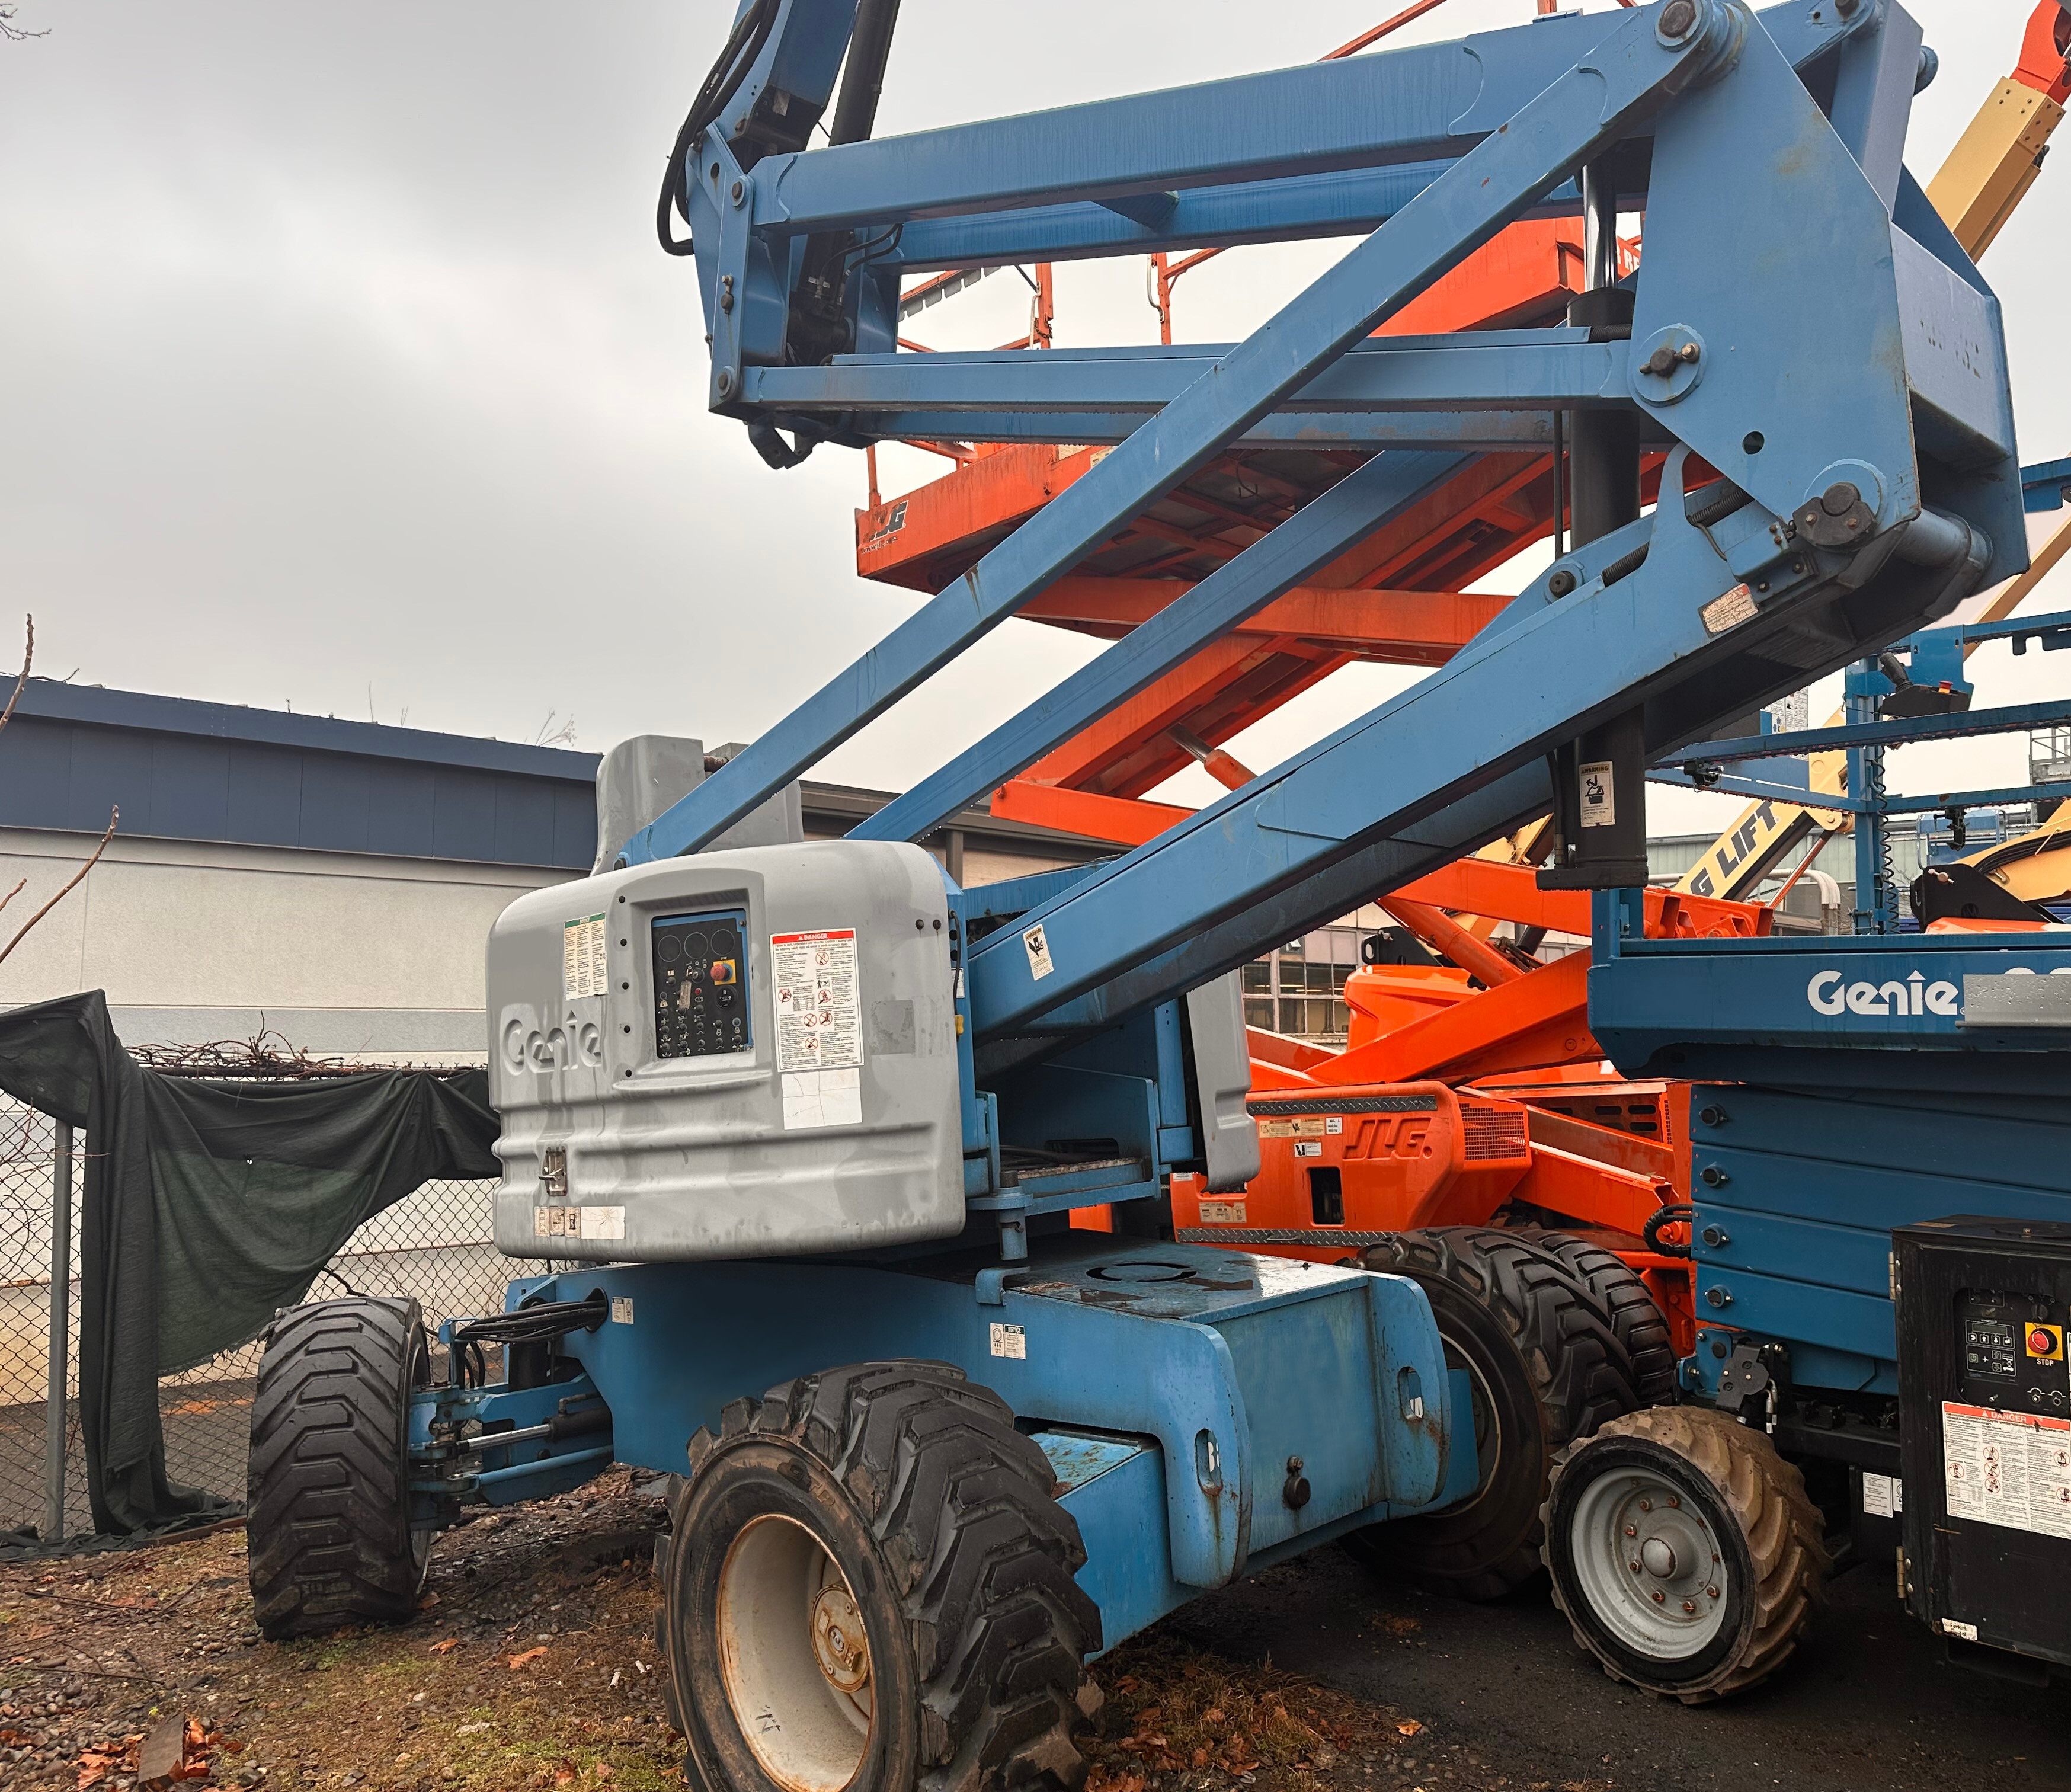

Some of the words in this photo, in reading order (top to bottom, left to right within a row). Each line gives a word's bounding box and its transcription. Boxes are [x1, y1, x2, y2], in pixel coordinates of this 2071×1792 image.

[1715, 800, 1776, 879] LIFT
[1807, 969, 1959, 1016] Genie
[503, 1010, 602, 1076] Genie
[1342, 1116, 1432, 1160] JLG
[2037, 1358, 2054, 1367] STOP
[1990, 1412, 2027, 1423] DANGER
